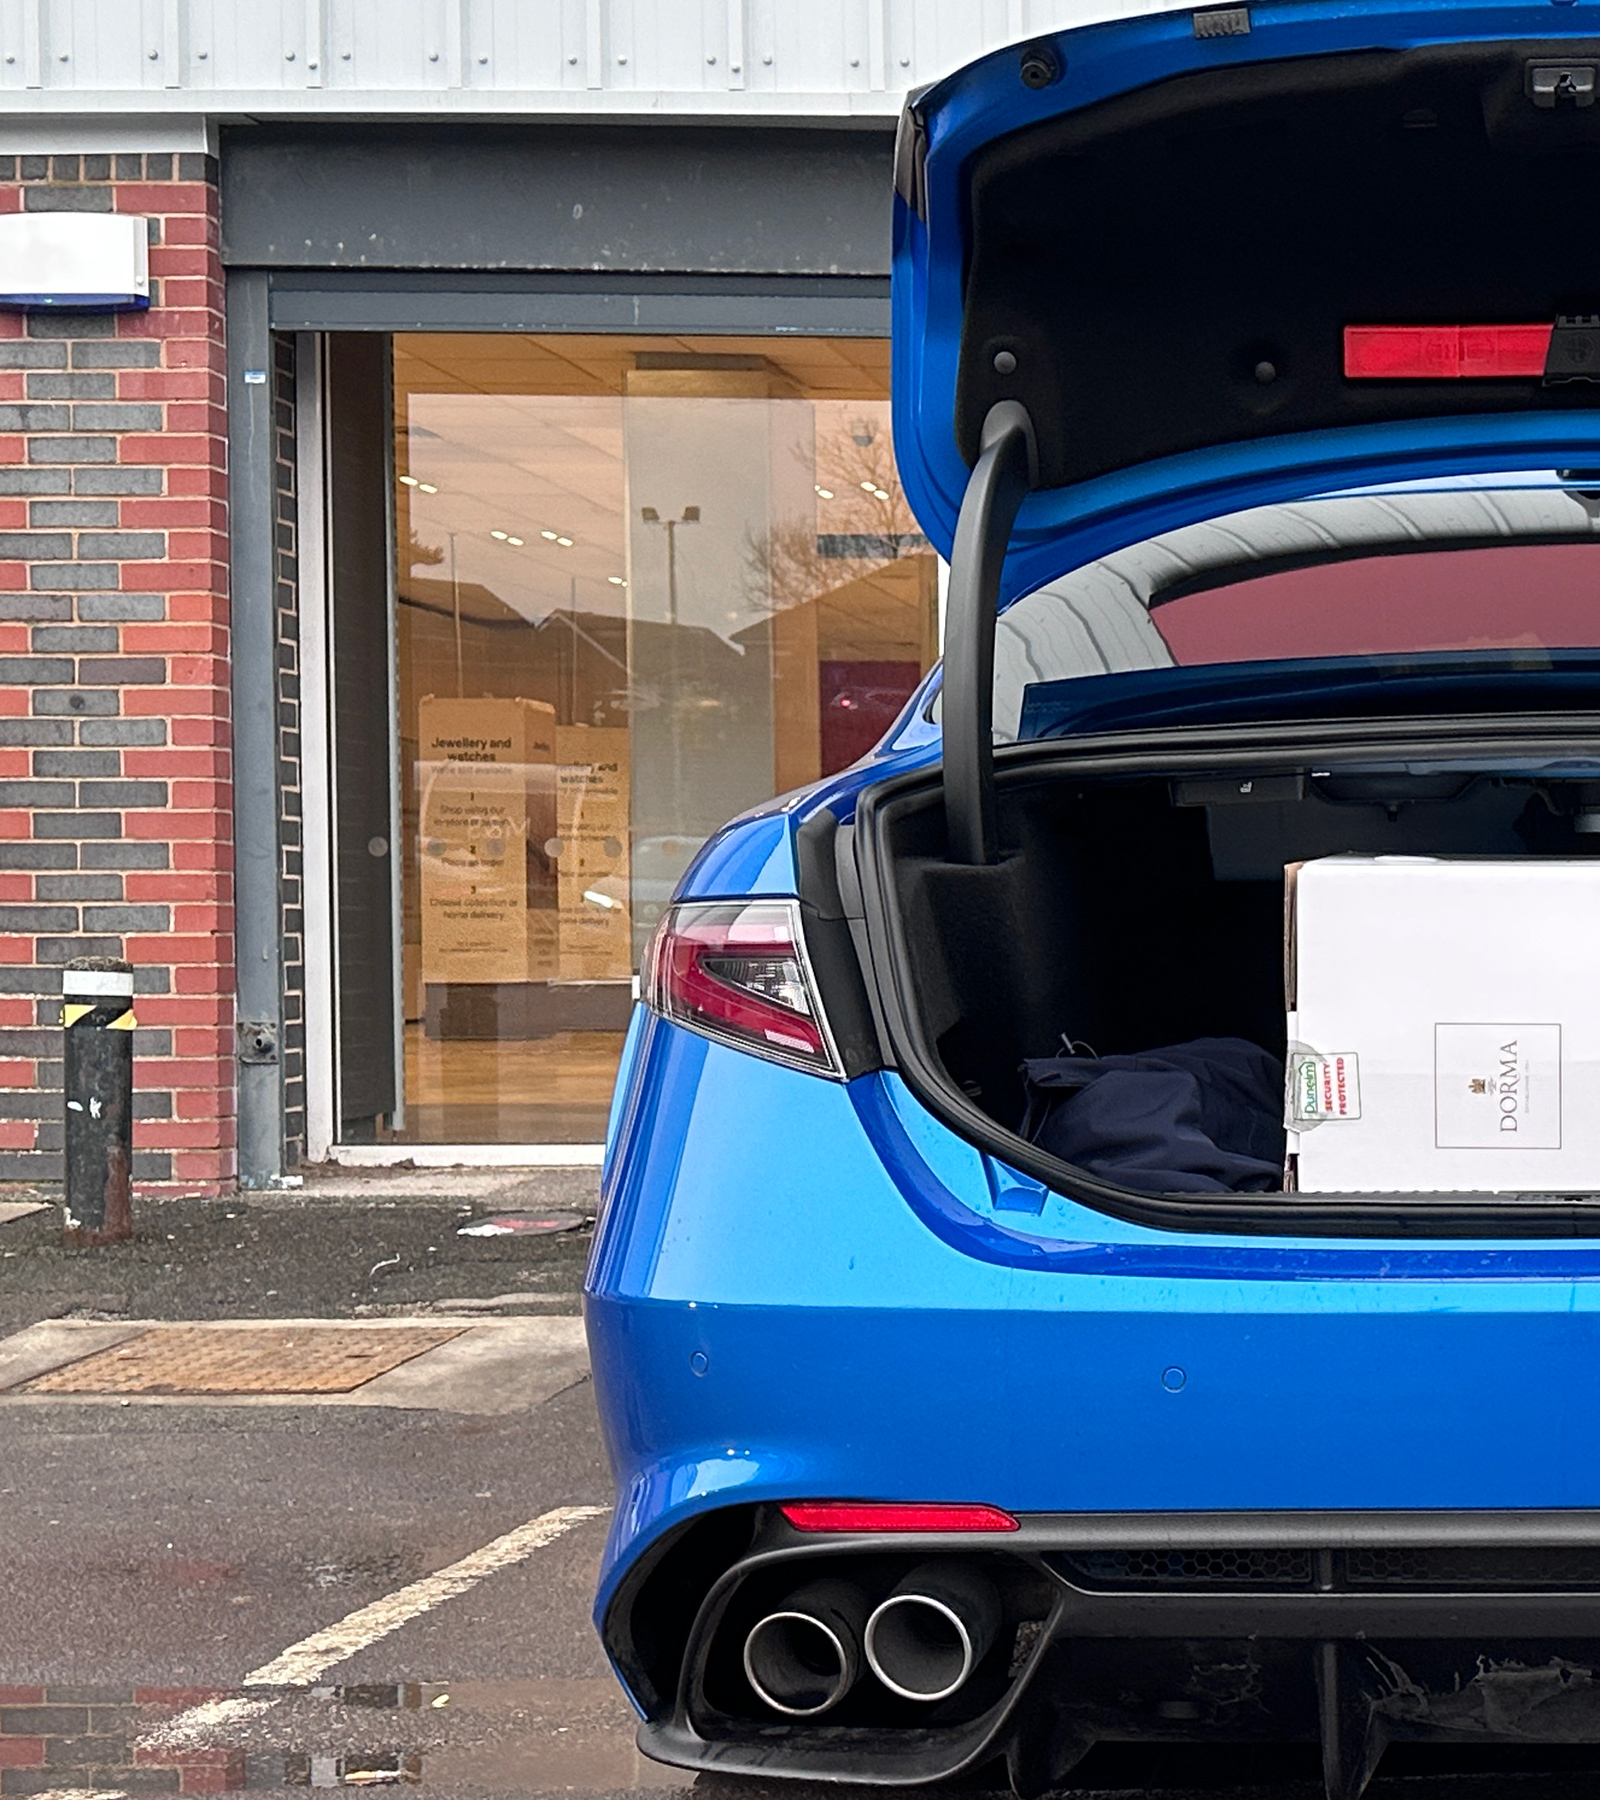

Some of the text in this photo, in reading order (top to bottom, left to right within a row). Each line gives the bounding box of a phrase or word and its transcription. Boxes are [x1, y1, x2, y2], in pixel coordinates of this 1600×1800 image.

[431, 737, 512, 751] Jewellery and
[447, 751, 497, 762] watches
[470, 792, 475, 801] 1
[470, 845, 476, 855] 2
[1323, 1063, 1333, 1112] SECURITY
[1336, 1057, 1347, 1115] PROTECTED
[1499, 1040, 1521, 1133] DORMA
